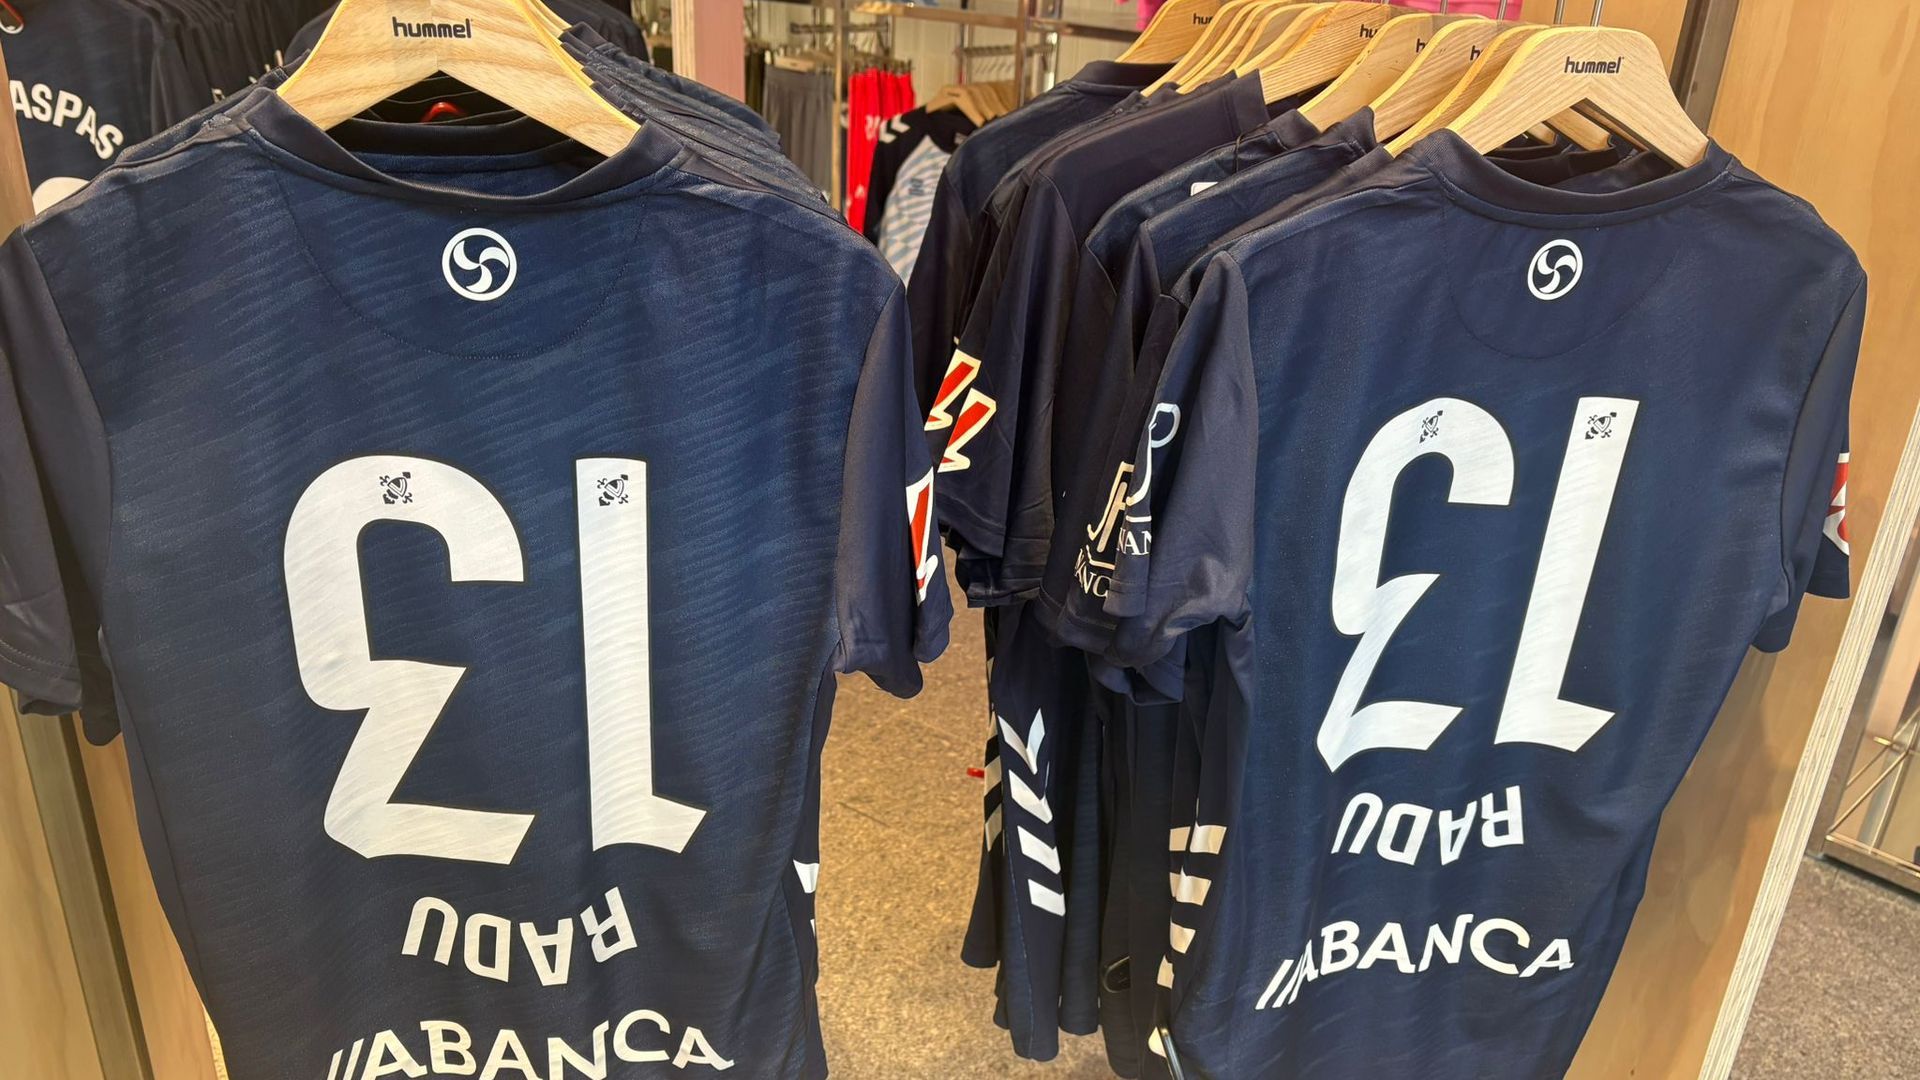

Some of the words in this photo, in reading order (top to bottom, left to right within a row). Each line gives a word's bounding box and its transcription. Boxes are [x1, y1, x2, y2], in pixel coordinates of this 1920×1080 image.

[392, 16, 473, 39] hummel
[1564, 56, 1622, 75] hummel
[10, 79, 125, 160] ASPAS
[1316, 396, 1640, 773] 13
[284, 455, 707, 865] 13
[1331, 785, 1524, 866] RADU
[401, 886, 638, 987] RADU
